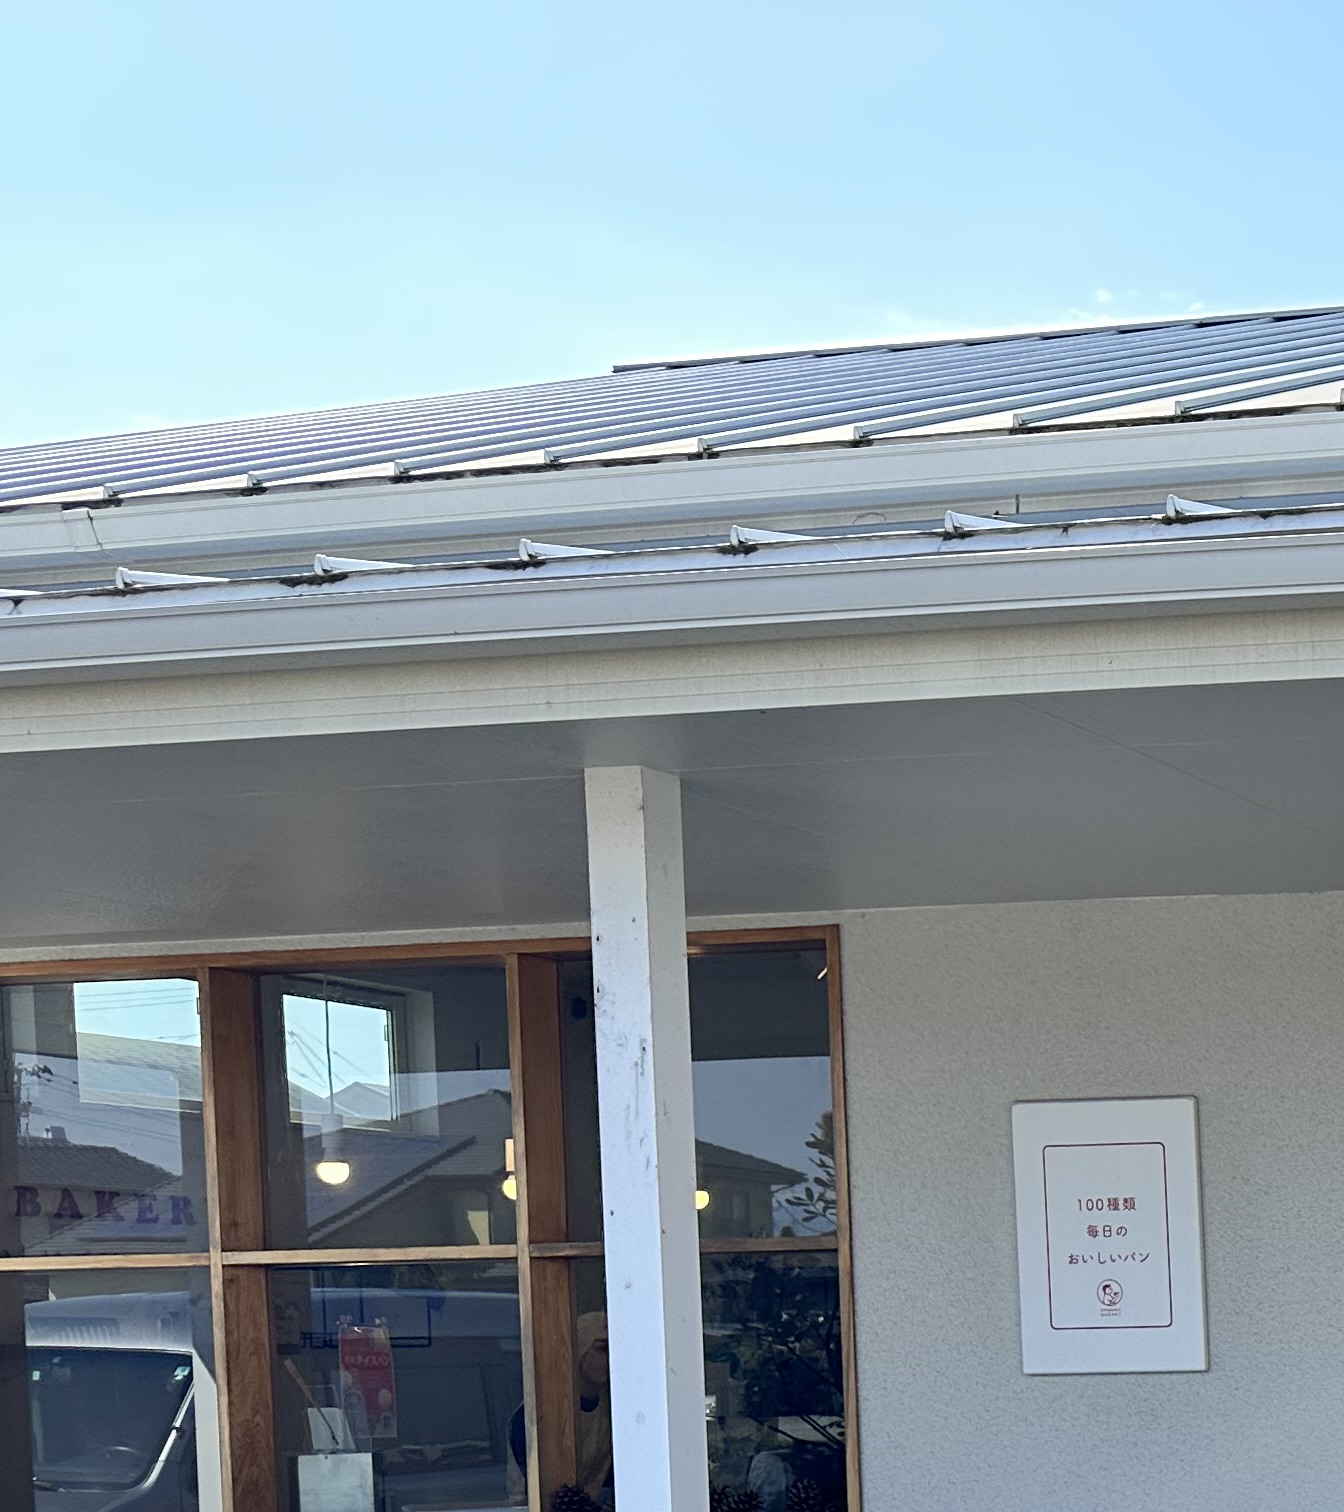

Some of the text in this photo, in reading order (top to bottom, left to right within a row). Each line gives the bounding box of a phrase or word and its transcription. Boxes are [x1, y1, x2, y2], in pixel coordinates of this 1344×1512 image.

[1076, 1196, 1137, 1212] 100種類
[1086, 1224, 1128, 1239] 毎日の
[1067, 1251, 1151, 1266] おいしいパン
